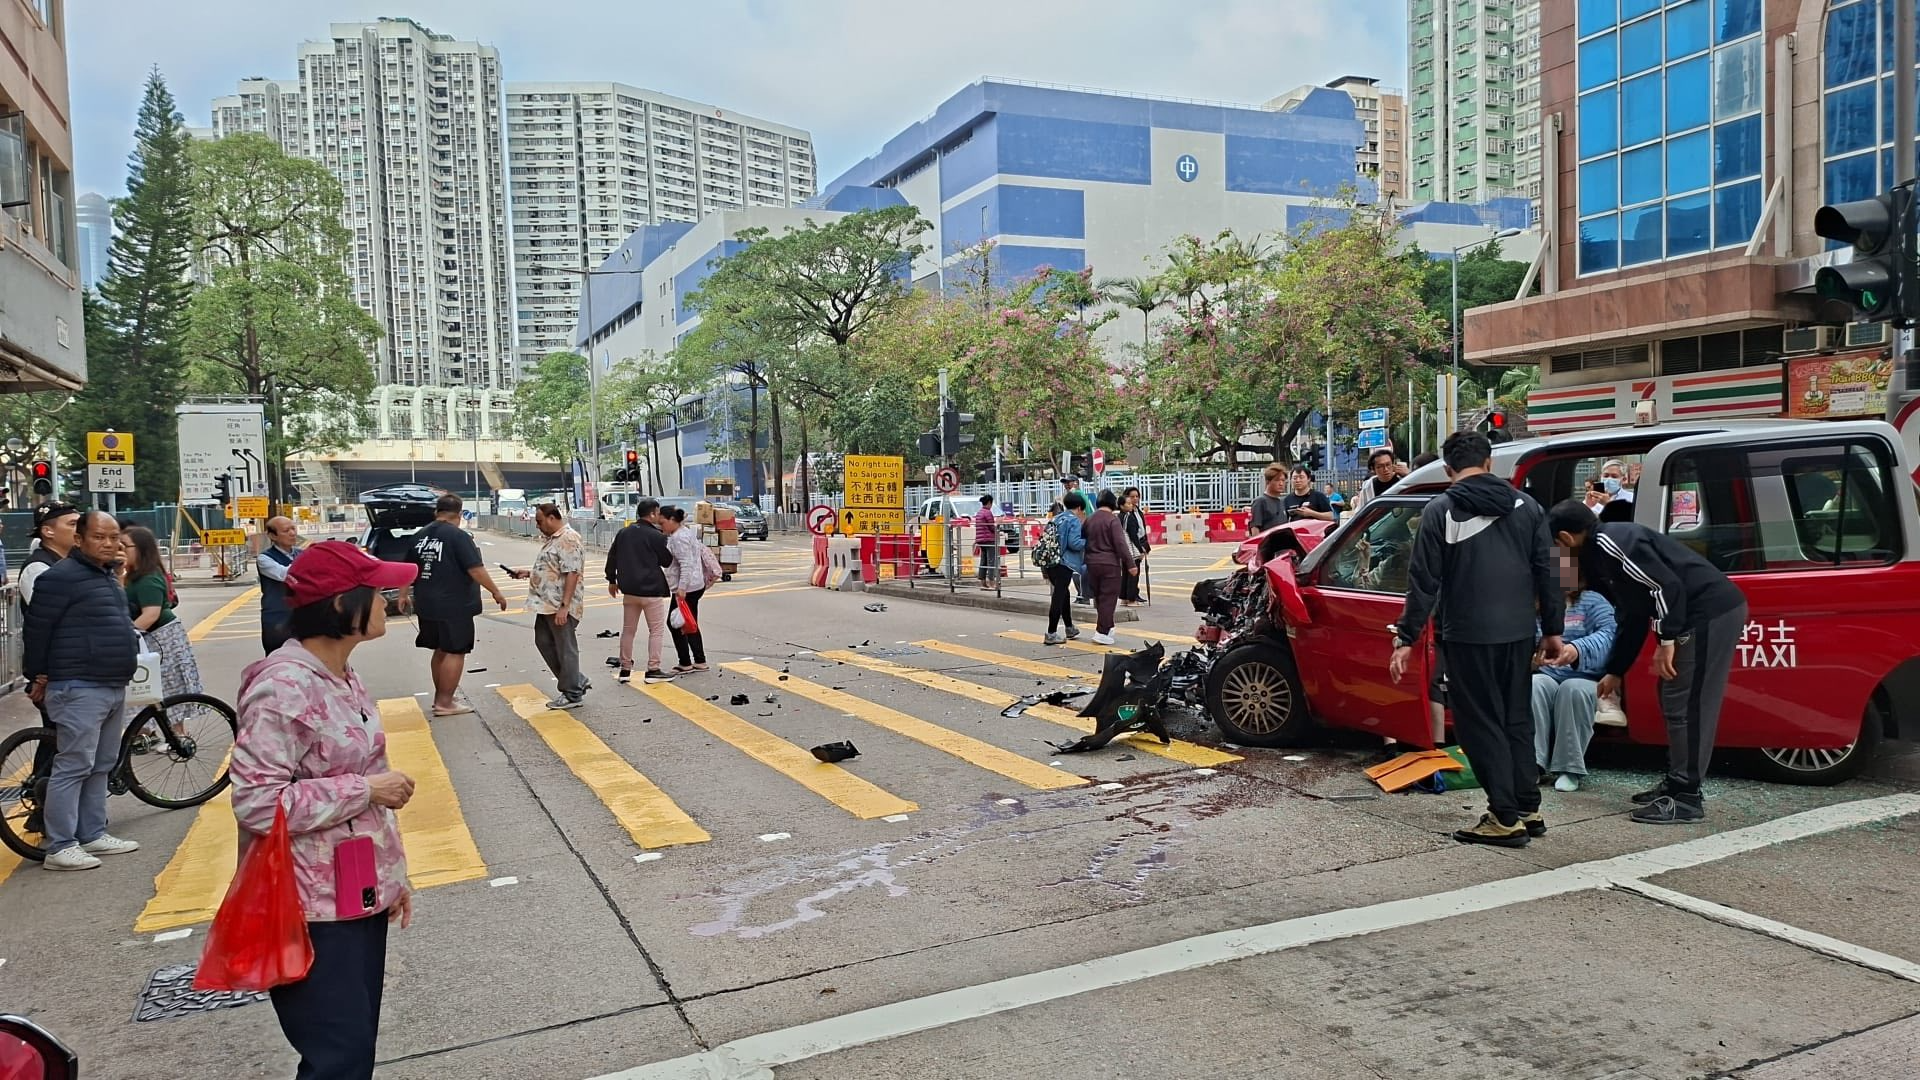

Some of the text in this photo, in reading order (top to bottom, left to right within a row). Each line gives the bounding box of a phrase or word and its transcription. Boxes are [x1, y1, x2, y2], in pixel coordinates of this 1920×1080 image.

[862, 460, 881, 469] right
[102, 467, 122, 476] End
[861, 471, 887, 479] Saigon
[97, 478, 126, 489] 終止
[851, 481, 897, 492] 不准右轉
[851, 493, 897, 504] 往西貢街
[858, 511, 886, 519] Canton
[859, 520, 891, 532] 廣東道
[1738, 619, 1796, 643] 的士
[1735, 644, 1796, 667] TAXI
